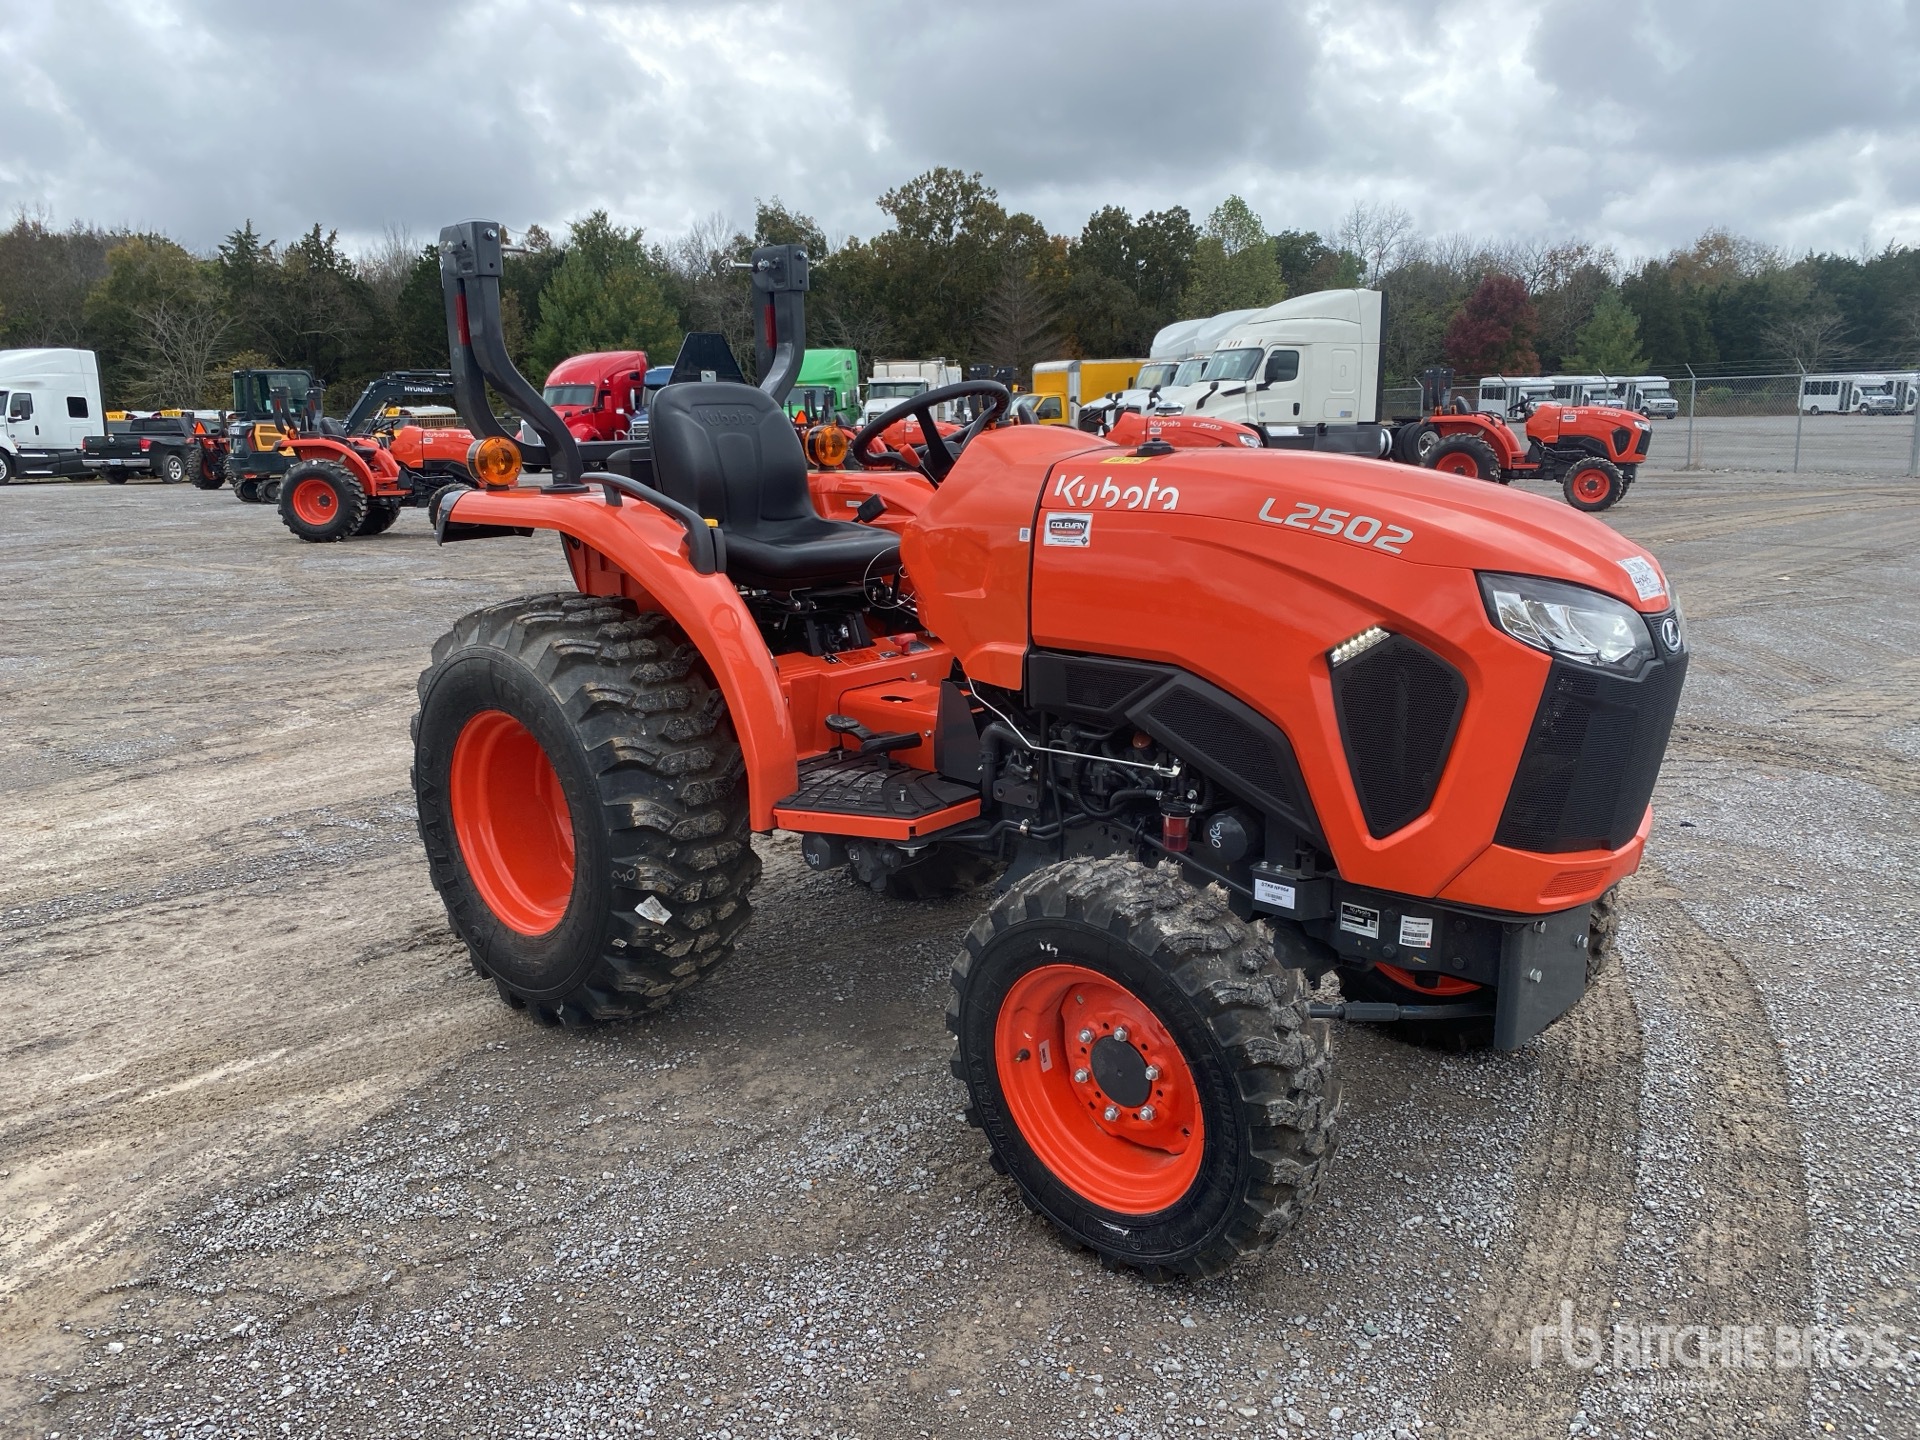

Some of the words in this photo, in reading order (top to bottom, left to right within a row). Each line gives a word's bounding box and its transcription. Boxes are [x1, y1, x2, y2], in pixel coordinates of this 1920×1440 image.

[404, 385, 433, 393] HYUNDAI
[697, 409, 757, 427] Kubota
[1150, 420, 1181, 428] Kubota
[1192, 422, 1222, 431] L2502
[1054, 475, 1180, 510] Kubota
[1050, 521, 1086, 529] COLEMAN
[1258, 497, 1414, 555] L2502
